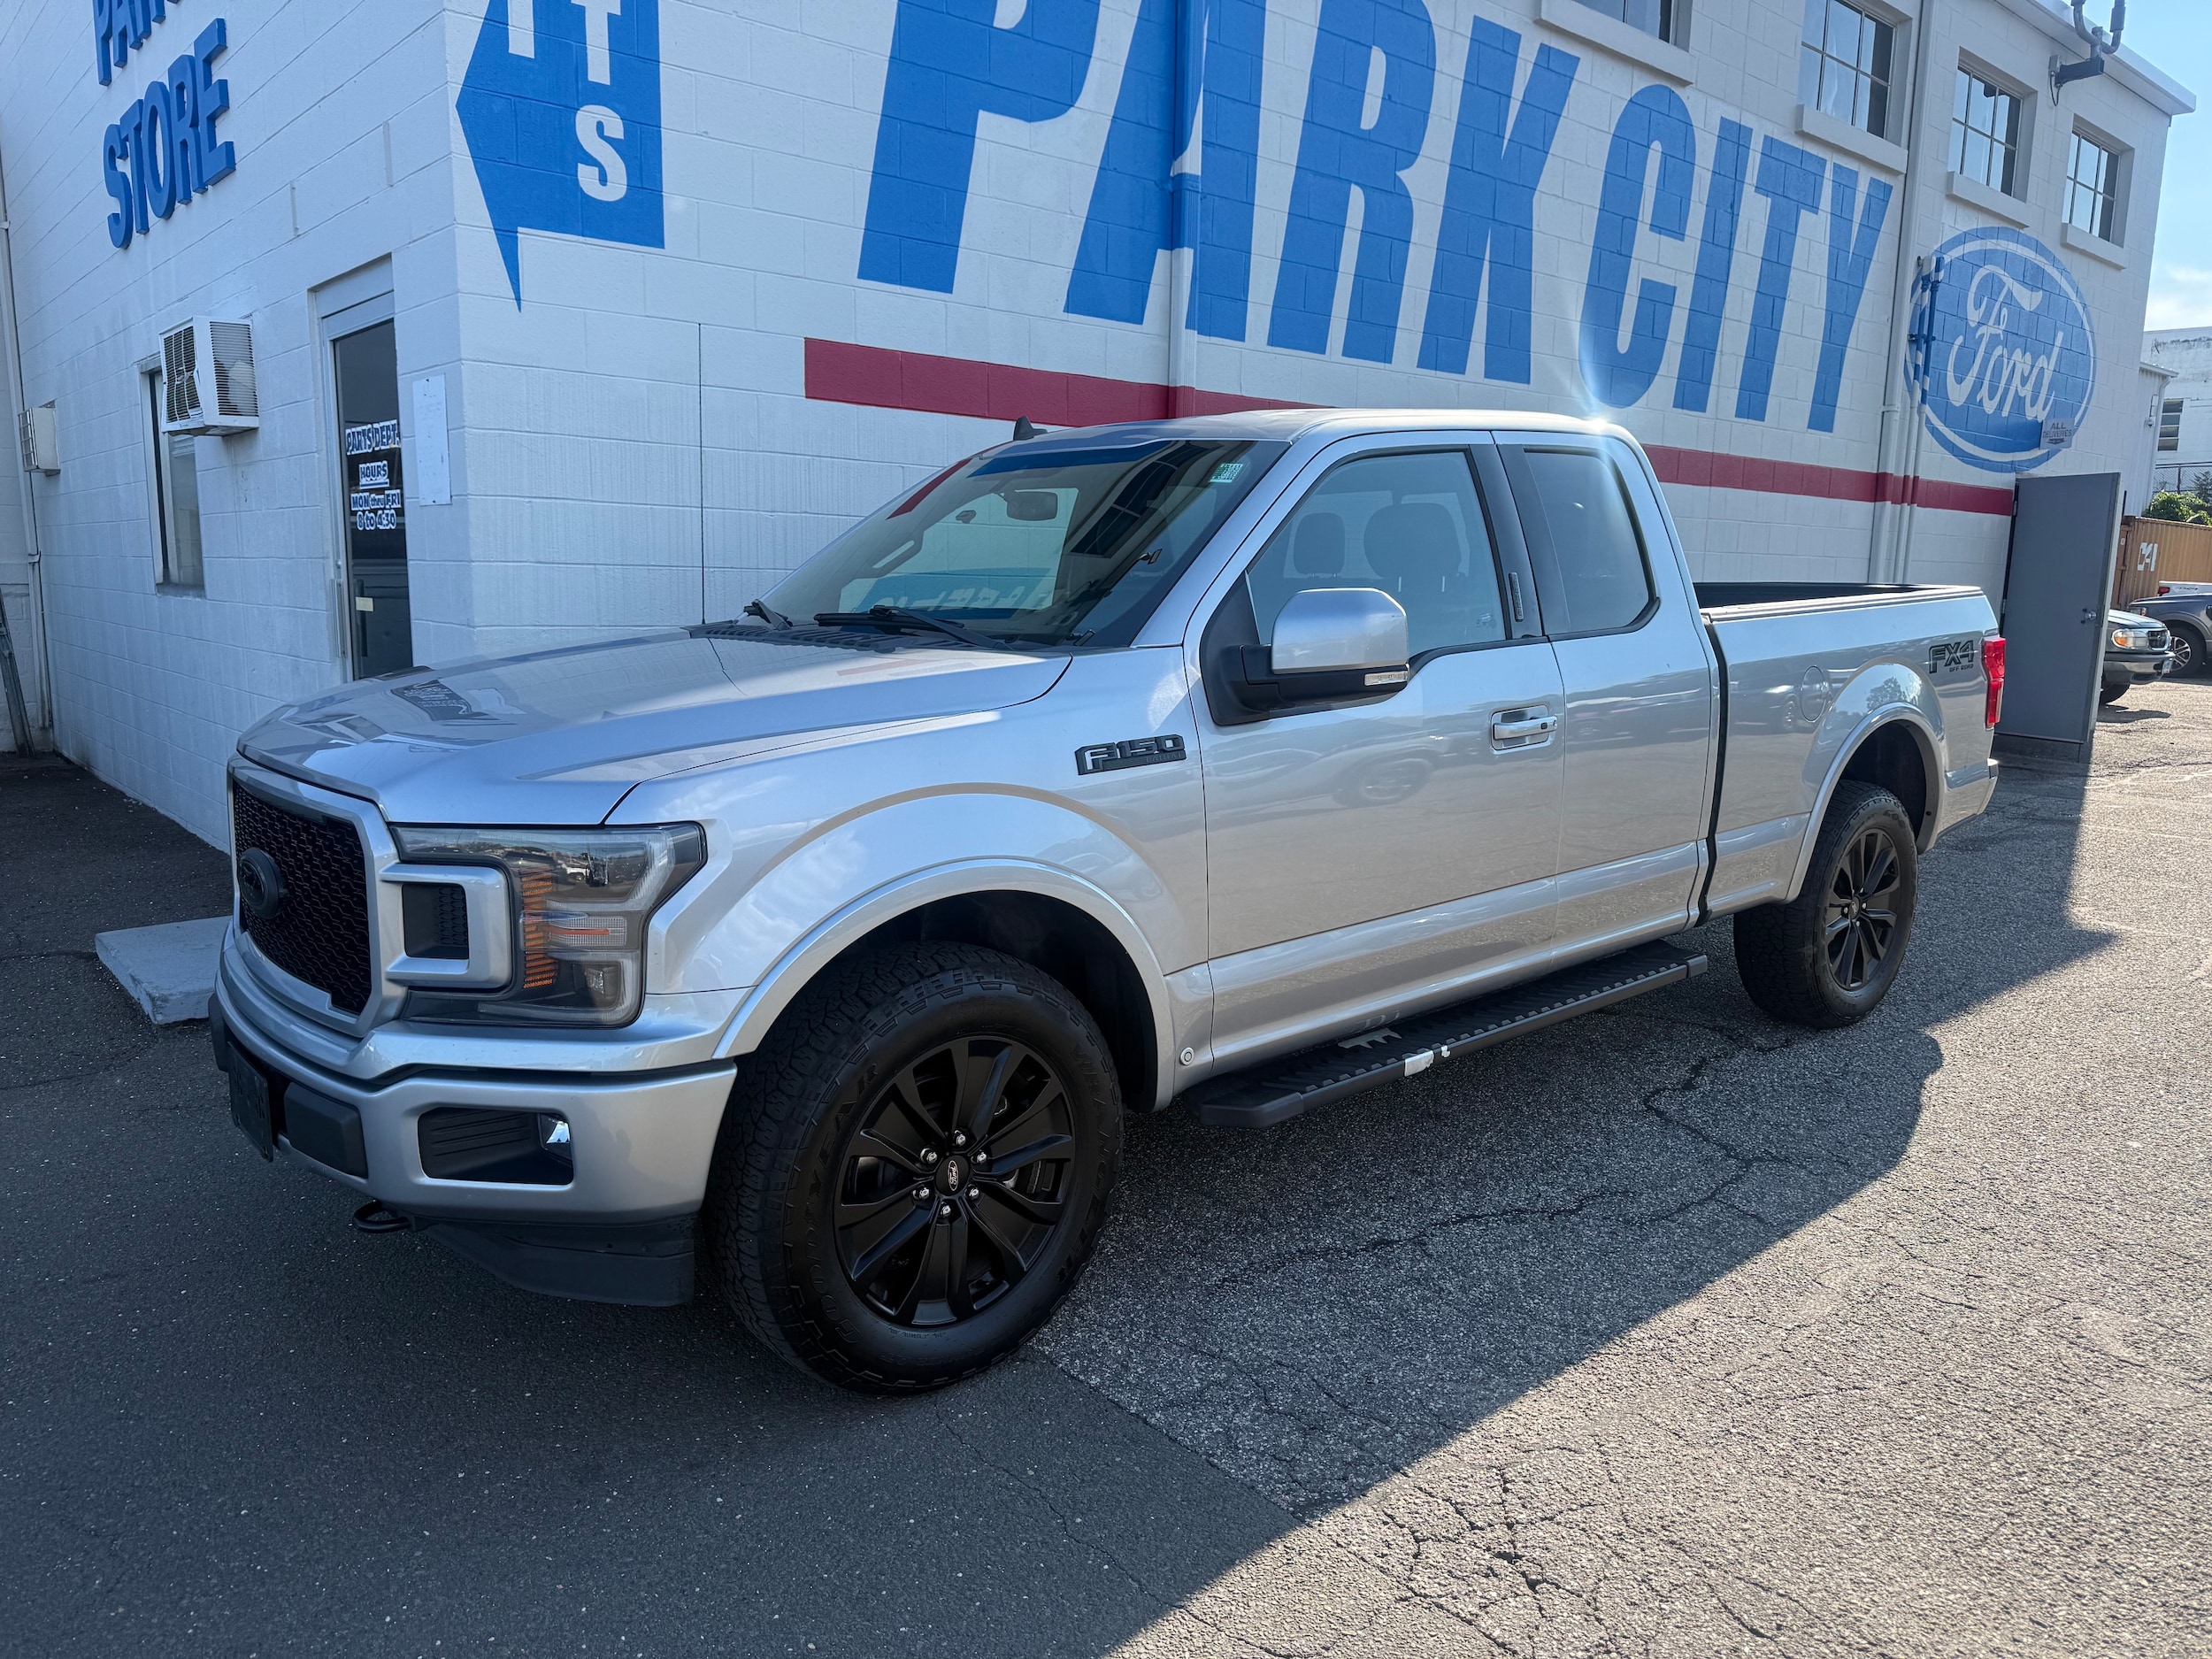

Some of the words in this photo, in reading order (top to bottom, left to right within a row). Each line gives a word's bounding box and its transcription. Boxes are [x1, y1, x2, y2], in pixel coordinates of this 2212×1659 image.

[104, 18, 236, 250] STORE
[856, 0, 1579, 384] PARK
[1578, 84, 1893, 433] CITY
[1947, 265, 2063, 422] Ford
[346, 426, 373, 454] PARTS
[359, 463, 388, 480] HOURS
[351, 493, 370, 510] MON
[385, 490, 401, 509] FRI
[357, 511, 365, 530] 8
[365, 511, 376, 529] to
[1929, 640, 1974, 673] FX4
